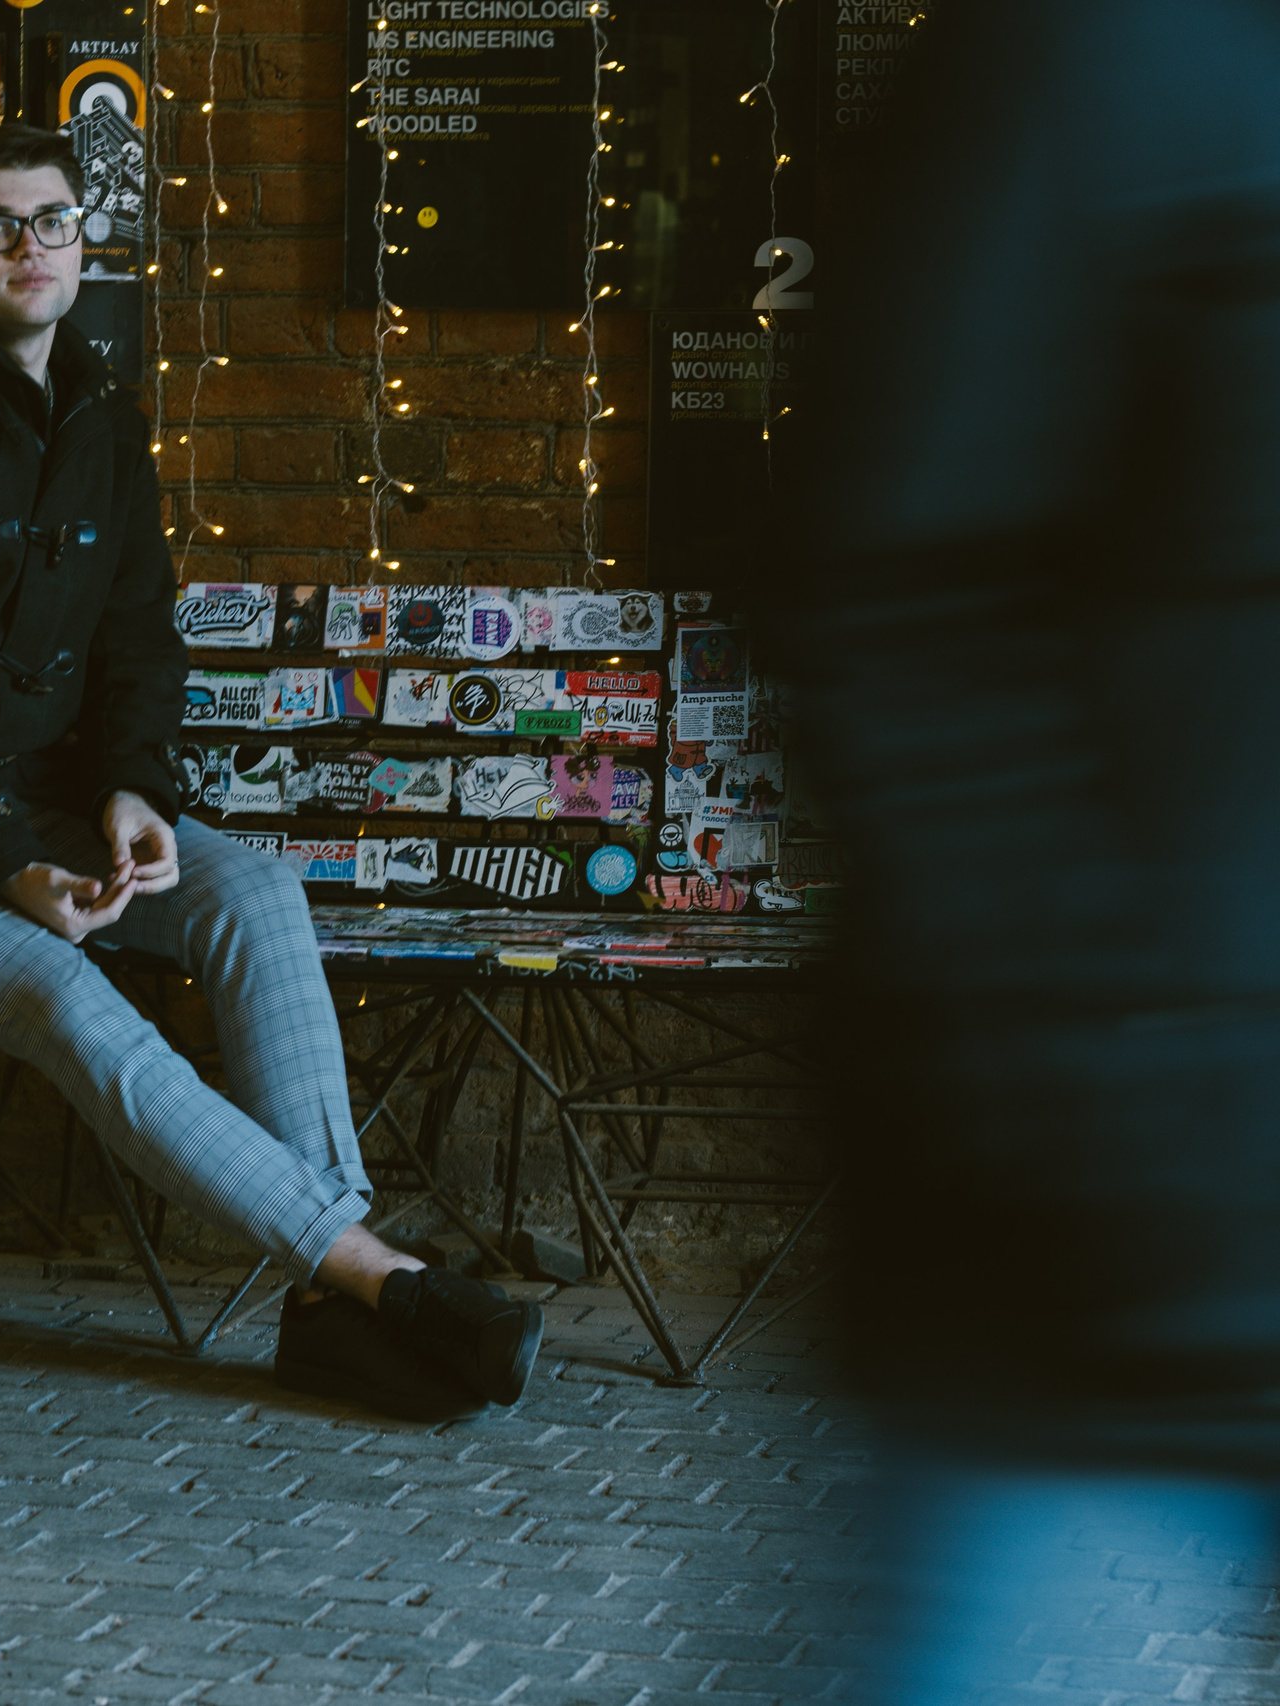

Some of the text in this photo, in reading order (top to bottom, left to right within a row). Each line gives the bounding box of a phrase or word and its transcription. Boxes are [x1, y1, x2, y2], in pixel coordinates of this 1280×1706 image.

[367, 0, 610, 20] LIGHT TECHNOLOGIES
[69, 40, 140, 55] ARTPLAY
[367, 30, 555, 49] MS ENGINEERING
[367, 58, 411, 77] RTC
[365, 86, 480, 105] THE SARAI
[366, 114, 477, 133] WOODLED
[108, 247, 130, 258] карту
[752, 236, 815, 310] 2
[671, 350, 748, 360] дизайн студия
[671, 361, 791, 379] WOWHAUS
[671, 391, 726, 410] КБ23
[587, 675, 641, 691] HELLO
[681, 693, 744, 705] Amparuche
[315, 761, 370, 775] MADE BY
[230, 791, 280, 805] torpedo
[318, 788, 367, 802] RIGINAL
[611, 795, 638, 807] WEET
